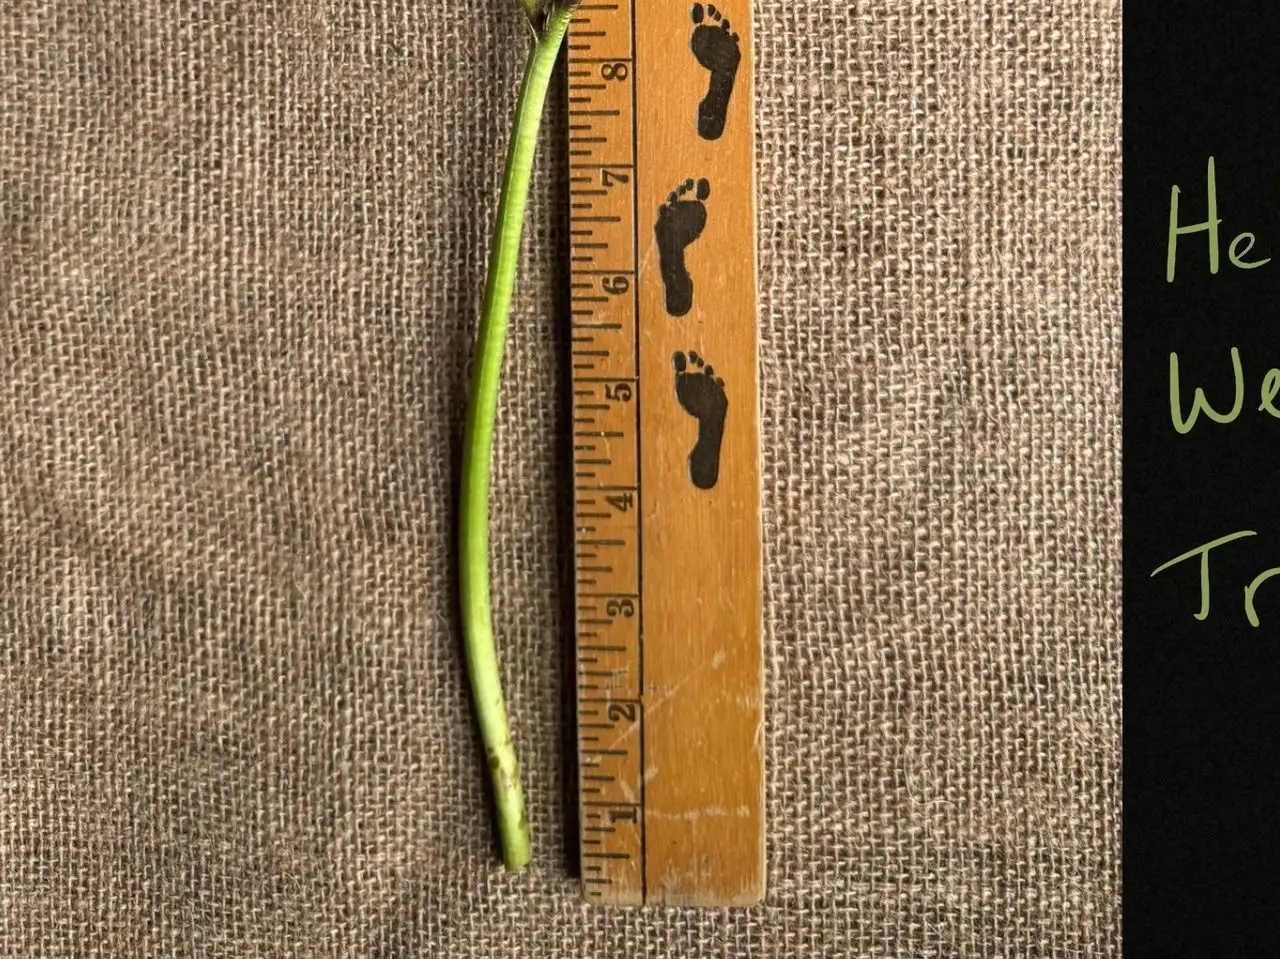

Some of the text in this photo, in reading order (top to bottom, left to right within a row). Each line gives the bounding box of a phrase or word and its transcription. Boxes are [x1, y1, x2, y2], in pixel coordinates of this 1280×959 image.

[601, 62, 629, 82] 8
[601, 168, 630, 187] 7
[602, 276, 630, 295] 6
[605, 382, 633, 402] 5
[605, 492, 634, 512] 4
[606, 598, 635, 619] 3
[608, 702, 637, 723] 2
[609, 807, 638, 825] 1
